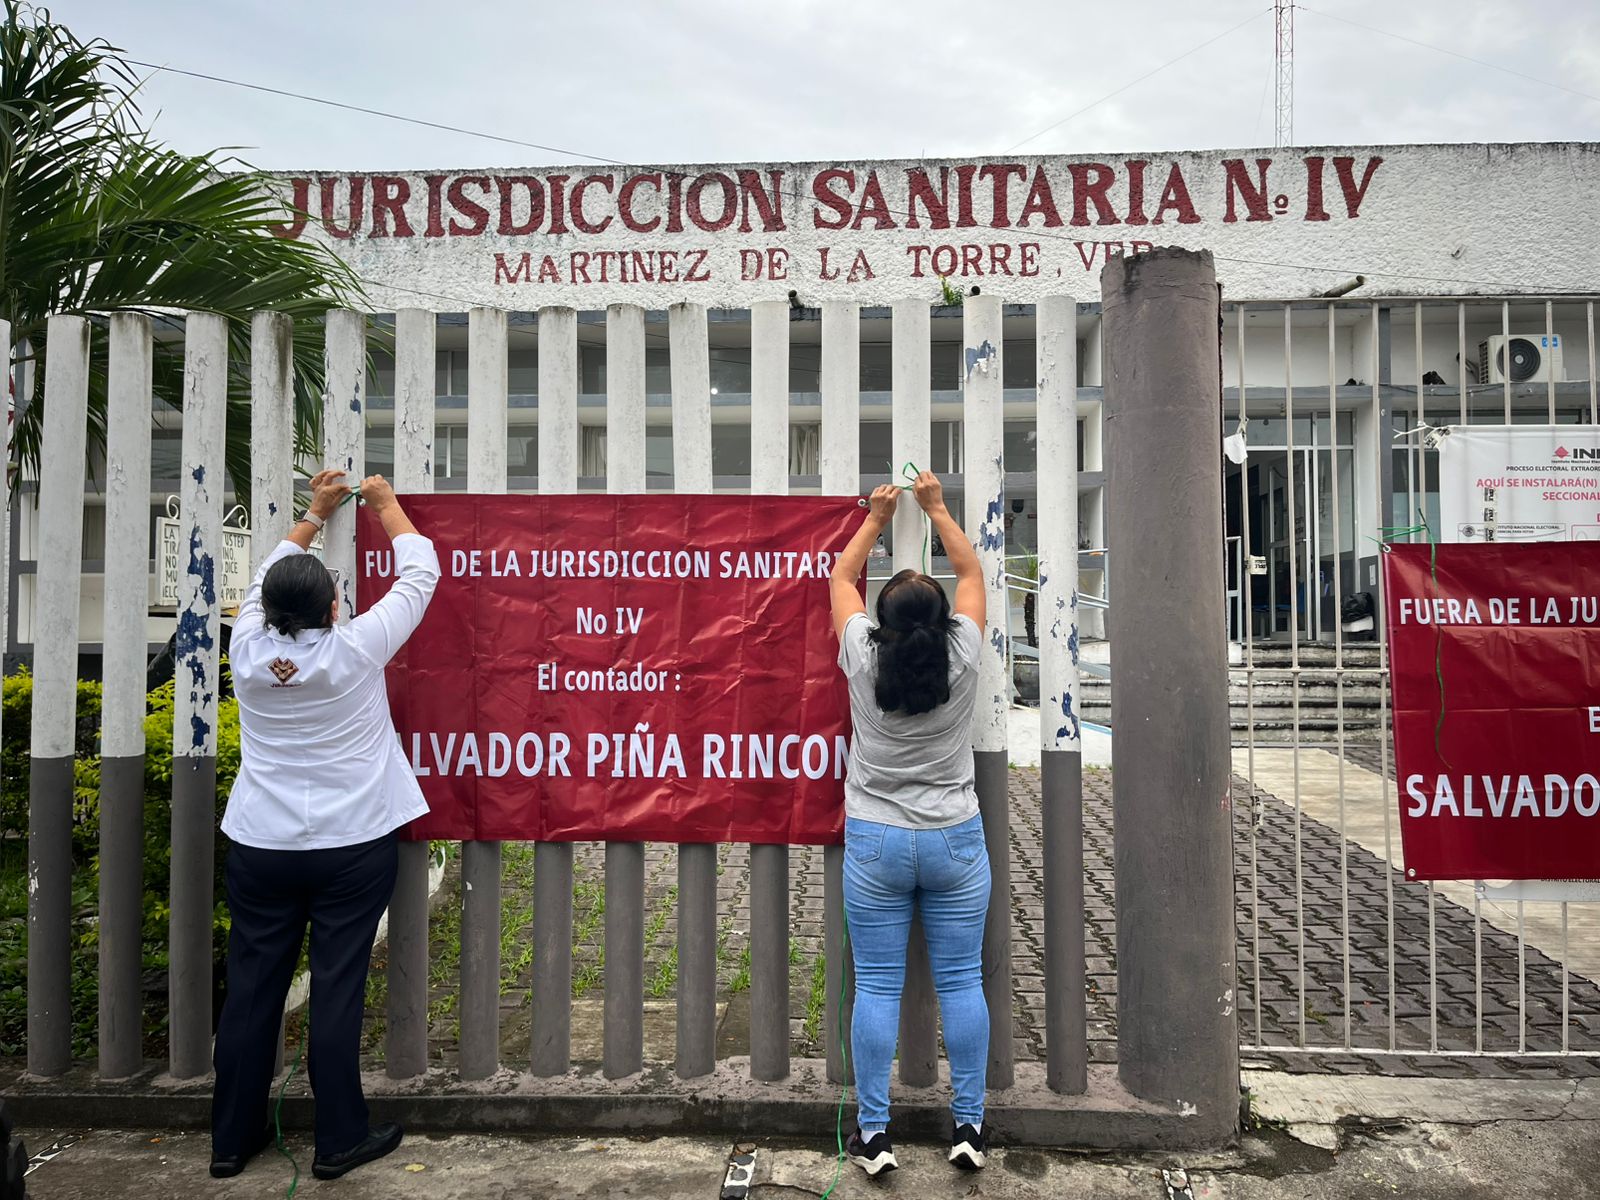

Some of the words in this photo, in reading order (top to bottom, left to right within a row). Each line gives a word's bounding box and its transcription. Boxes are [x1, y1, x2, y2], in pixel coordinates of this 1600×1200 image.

[266, 169, 786, 240] JURISDICCION
[813, 159, 1201, 230] SANITARIA
[1304, 156, 1383, 221] IV
[494, 248, 710, 285] MARTINEZ
[740, 247, 790, 281] DE
[818, 247, 876, 283] LA
[1476, 477, 1505, 489] AQUÍ
[1507, 478, 1520, 488] SE
[1522, 477, 1598, 490] INSTALARÁ(N)
[164, 527, 175, 540] LA
[224, 534, 245, 548] USTED
[165, 555, 177, 569] NO
[224, 561, 238, 574] DICE
[451, 549, 482, 577] DE
[491, 549, 521, 577] LA
[529, 549, 711, 578] JURISDICCION
[719, 550, 862, 579] SANITAR
[225, 589, 237, 601] POR
[577, 606, 607, 635] No
[615, 607, 644, 635] IV
[1400, 598, 1482, 625] FUERA
[1489, 597, 1520, 624] DE
[1530, 597, 1561, 624] LA
[538, 662, 556, 691] El
[564, 662, 667, 692] contador
[396, 731, 571, 777] LVADOR
[587, 722, 687, 779] PIÑA
